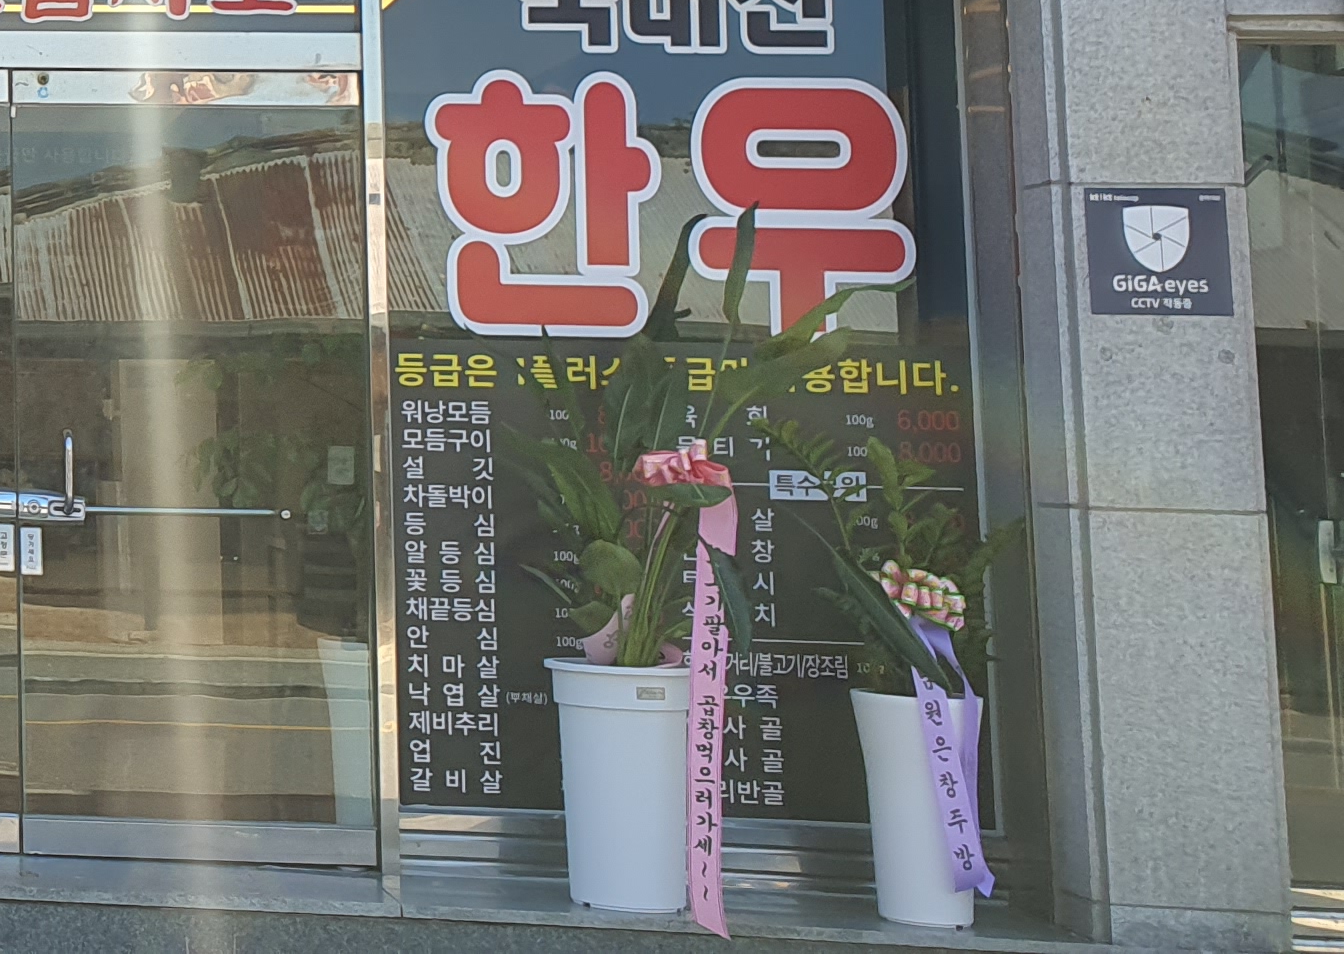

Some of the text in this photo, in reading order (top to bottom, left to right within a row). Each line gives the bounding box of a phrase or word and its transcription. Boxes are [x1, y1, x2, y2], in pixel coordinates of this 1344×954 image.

[424, 69, 917, 339] 한우
[1164, 278, 1209, 296] eyes
[1130, 297, 1160, 309] CCTV
[395, 353, 498, 390] 등급은
[790, 358, 960, 396] 용합니다.
[401, 399, 492, 425] 워낭모듬
[845, 414, 875, 429] 100g
[897, 409, 960, 434] 6,000
[401, 428, 492, 454] 모듬구이
[403, 484, 494, 510] 차돌박이
[405, 596, 496, 623] 채끝등심
[695, 576, 728, 682] 기팔아서
[408, 710, 499, 738] 제비추리
